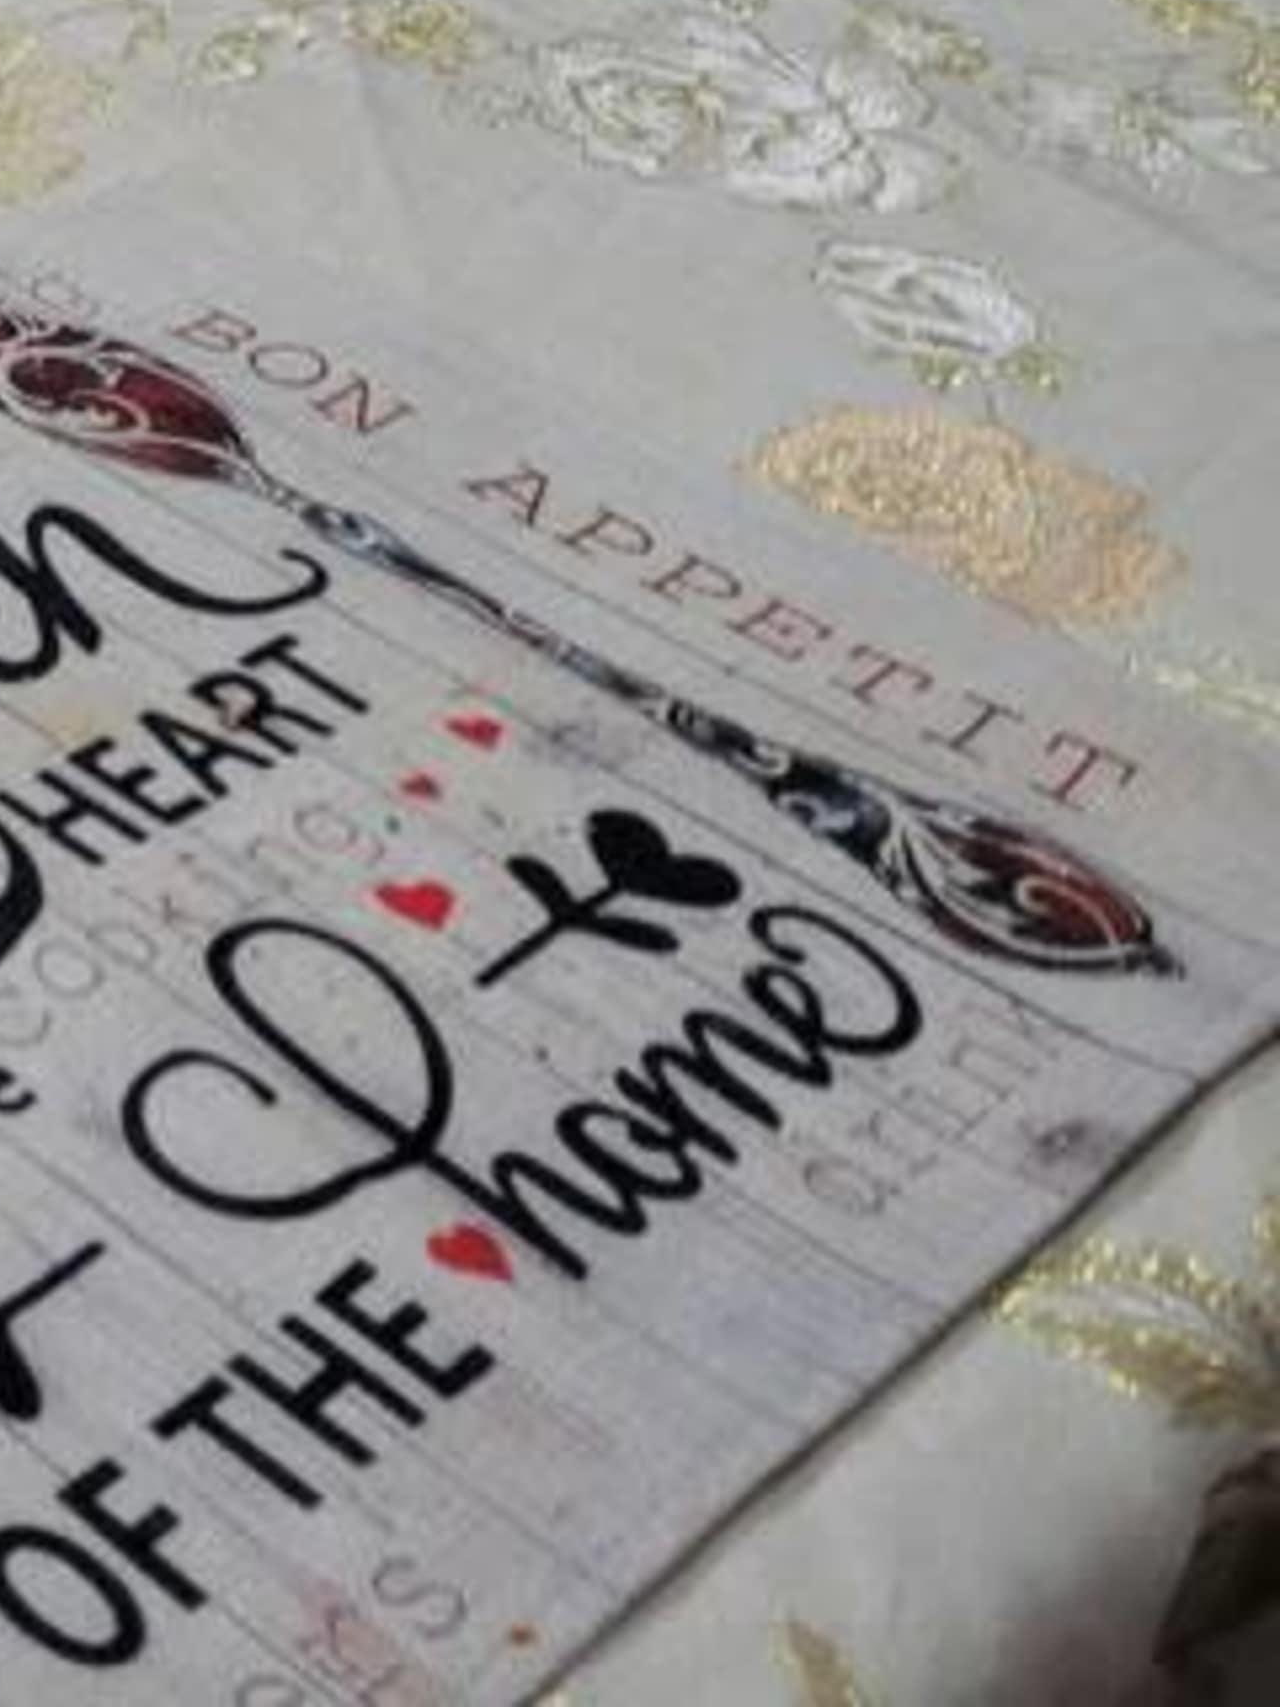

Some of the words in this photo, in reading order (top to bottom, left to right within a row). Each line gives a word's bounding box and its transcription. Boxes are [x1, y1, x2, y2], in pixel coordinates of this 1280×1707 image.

[169, 308, 416, 439] BON
[462, 457, 1140, 815] APPETIT
[122, 905, 922, 1282] home
[149, 1257, 497, 1511] THE
